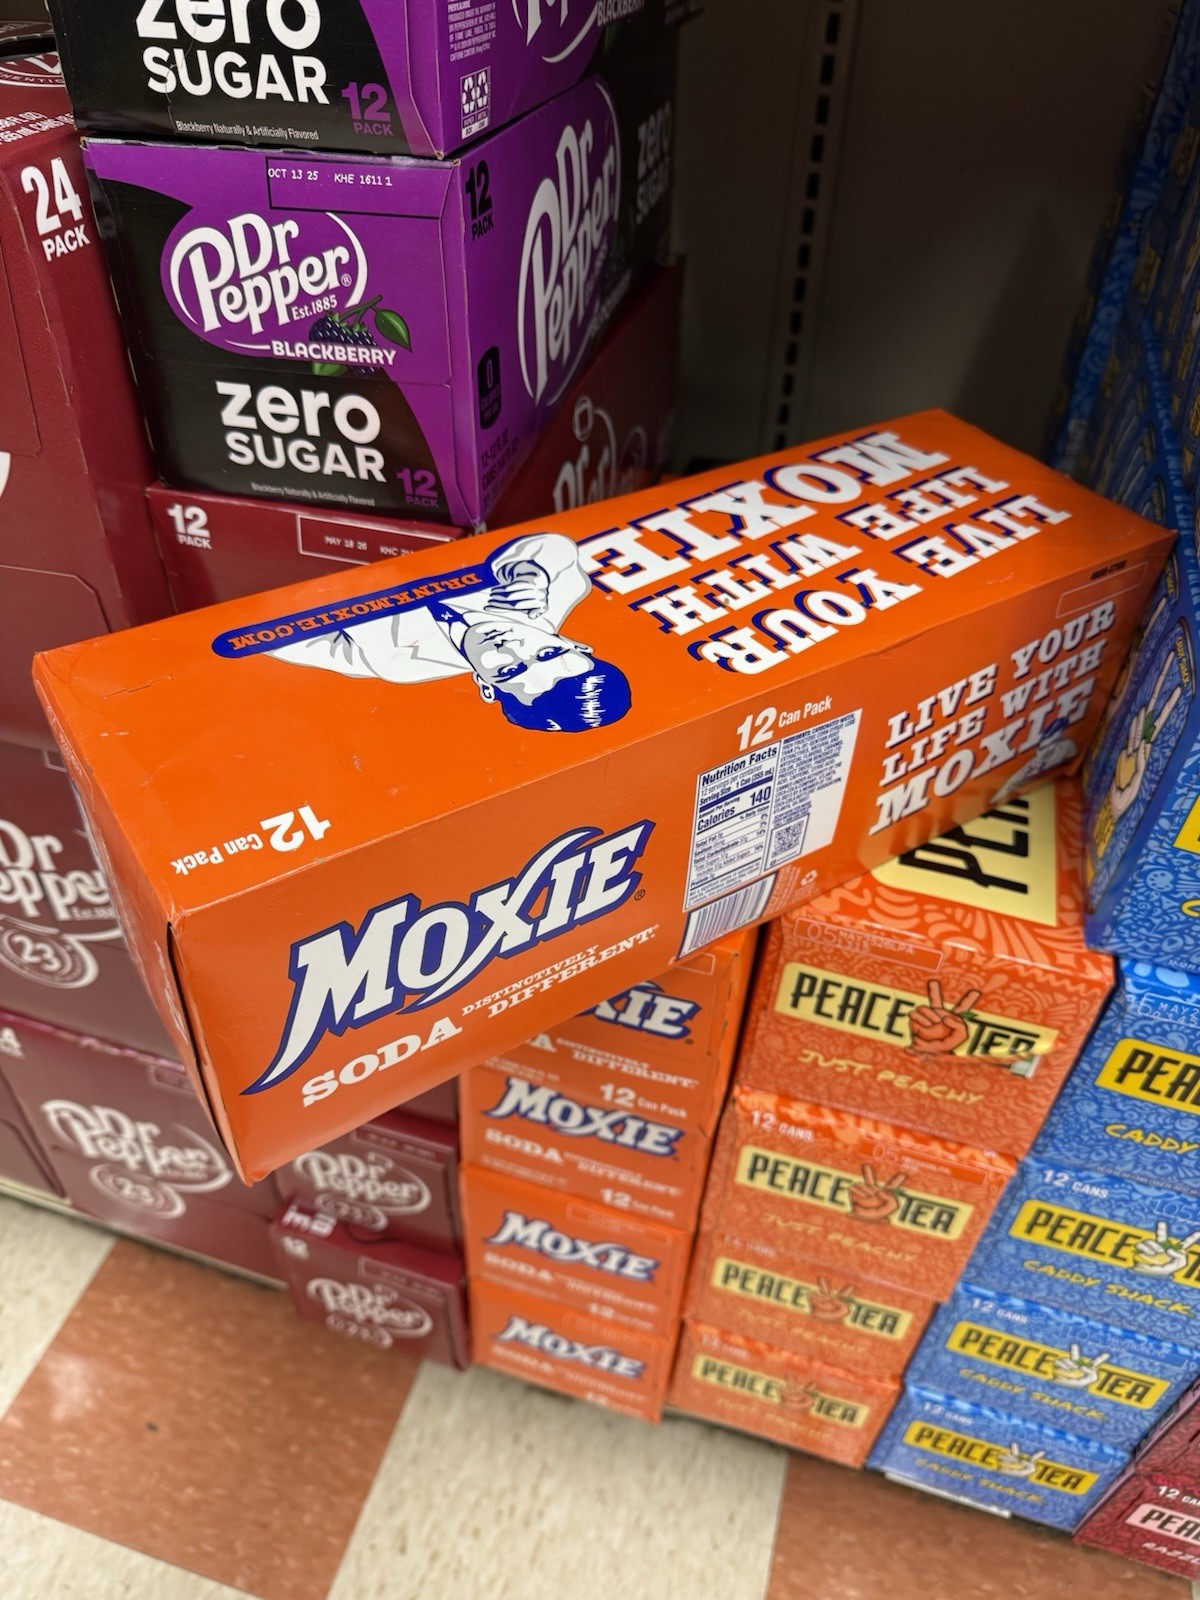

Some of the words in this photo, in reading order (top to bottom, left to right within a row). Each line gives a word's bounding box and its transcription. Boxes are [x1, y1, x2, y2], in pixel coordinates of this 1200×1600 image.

[136, 0, 321, 50] zero
[143, 46, 330, 105] SUGAR
[341, 82, 391, 122] 12
[176, 120, 214, 136] Blackberry
[214, 124, 246, 138] Naturally
[252, 126, 288, 140] Artificially
[288, 128, 319, 141] Flavored
[354, 121, 394, 137] PACK
[20, 157, 83, 236] 24
[268, 168, 286, 180] OCT
[291, 169, 303, 181] 13
[307, 170, 319, 182] 25
[334, 173, 354, 185] KHE
[465, 161, 494, 220] 12
[42, 225, 90, 262] PACK
[227, 212, 300, 279] Dr
[471, 212, 494, 241] PACK
[170, 225, 350, 335] Pepper
[290, 295, 338, 321] Est.1885
[271, 340, 397, 366] BLACKBERRY
[215, 380, 381, 444] zero
[225, 431, 387, 483] SUGAR
[396, 467, 438, 497] 12
[167, 503, 211, 539] 12
[405, 496, 440, 510] PACK
[578, 430, 951, 596] MOXIE
[835, 465, 1012, 542] LIFE
[178, 534, 212, 550] PACK
[325, 536, 341, 547] MAY
[893, 494, 1074, 580] LIVE
[628, 533, 864, 637] WITH
[227, 573, 483, 652] DRINKMOXIE.COM
[688, 567, 924, 676] YOUR
[885, 663, 999, 750] LIVE
[1010, 600, 1116, 681] YOUR
[736, 706, 777, 752] 12
[778, 709, 801, 728] Can
[802, 695, 833, 719] Pack
[879, 706, 988, 788] LIFE
[999, 639, 1108, 720] WITH
[702, 759, 746, 787] Nutrition
[749, 746, 778, 765] Facts
[868, 677, 1097, 837] MOXIE
[260, 805, 332, 853] 12
[697, 806, 736, 832] Calories
[750, 785, 772, 807] 140
[170, 841, 225, 876] Pack
[223, 830, 264, 855] Can
[11, 935, 62, 972] 23
[240, 819, 657, 1096] MOXIE
[461, 944, 600, 1017] DISTINCTIVELY
[789, 971, 916, 1040] PEACE
[301, 1016, 464, 1108] SODA
[556, 1036, 651, 1070] DISTINCTIVELY
[797, 1048, 873, 1078] JUST
[876, 1068, 986, 1106] PEACHY
[92, 1104, 162, 1143] Dr
[481, 1075, 685, 1157] MOXIE
[599, 1082, 637, 1108] 12
[637, 1096, 659, 1111] Can
[660, 1102, 688, 1119] Pack
[751, 1109, 777, 1130] 12
[779, 1121, 816, 1143] CANS
[484, 1127, 565, 1165] SODA
[1105, 1122, 1199, 1155] CADDY
[294, 1150, 420, 1202] Pepper
[338, 1153, 388, 1181] Dr
[1042, 1169, 1070, 1188] 12
[1072, 1181, 1109, 1200] CANS
[600, 1187, 633, 1210] 12
[747, 1153, 854, 1207] PEACE
[896, 1192, 960, 1234] TEA
[484, 1209, 660, 1282] MOXIE
[1024, 1207, 1143, 1263] PEACE
[720, 1261, 814, 1312] PEACE
[846, 1298, 903, 1336] TEA
[969, 1297, 996, 1314] 12
[1023, 1260, 1102, 1288] CADDY
[1104, 1283, 1193, 1316] SHACK
[493, 1314, 647, 1380] MOXIE
[958, 1326, 1060, 1376] PEACE
[1094, 1367, 1156, 1403] TEA
[700, 1356, 782, 1399] PEACE
[812, 1394, 861, 1424] TEA
[914, 1425, 1002, 1469] PEACE
[1034, 1458, 1087, 1492] TEA
[1158, 1485, 1180, 1500] 12
